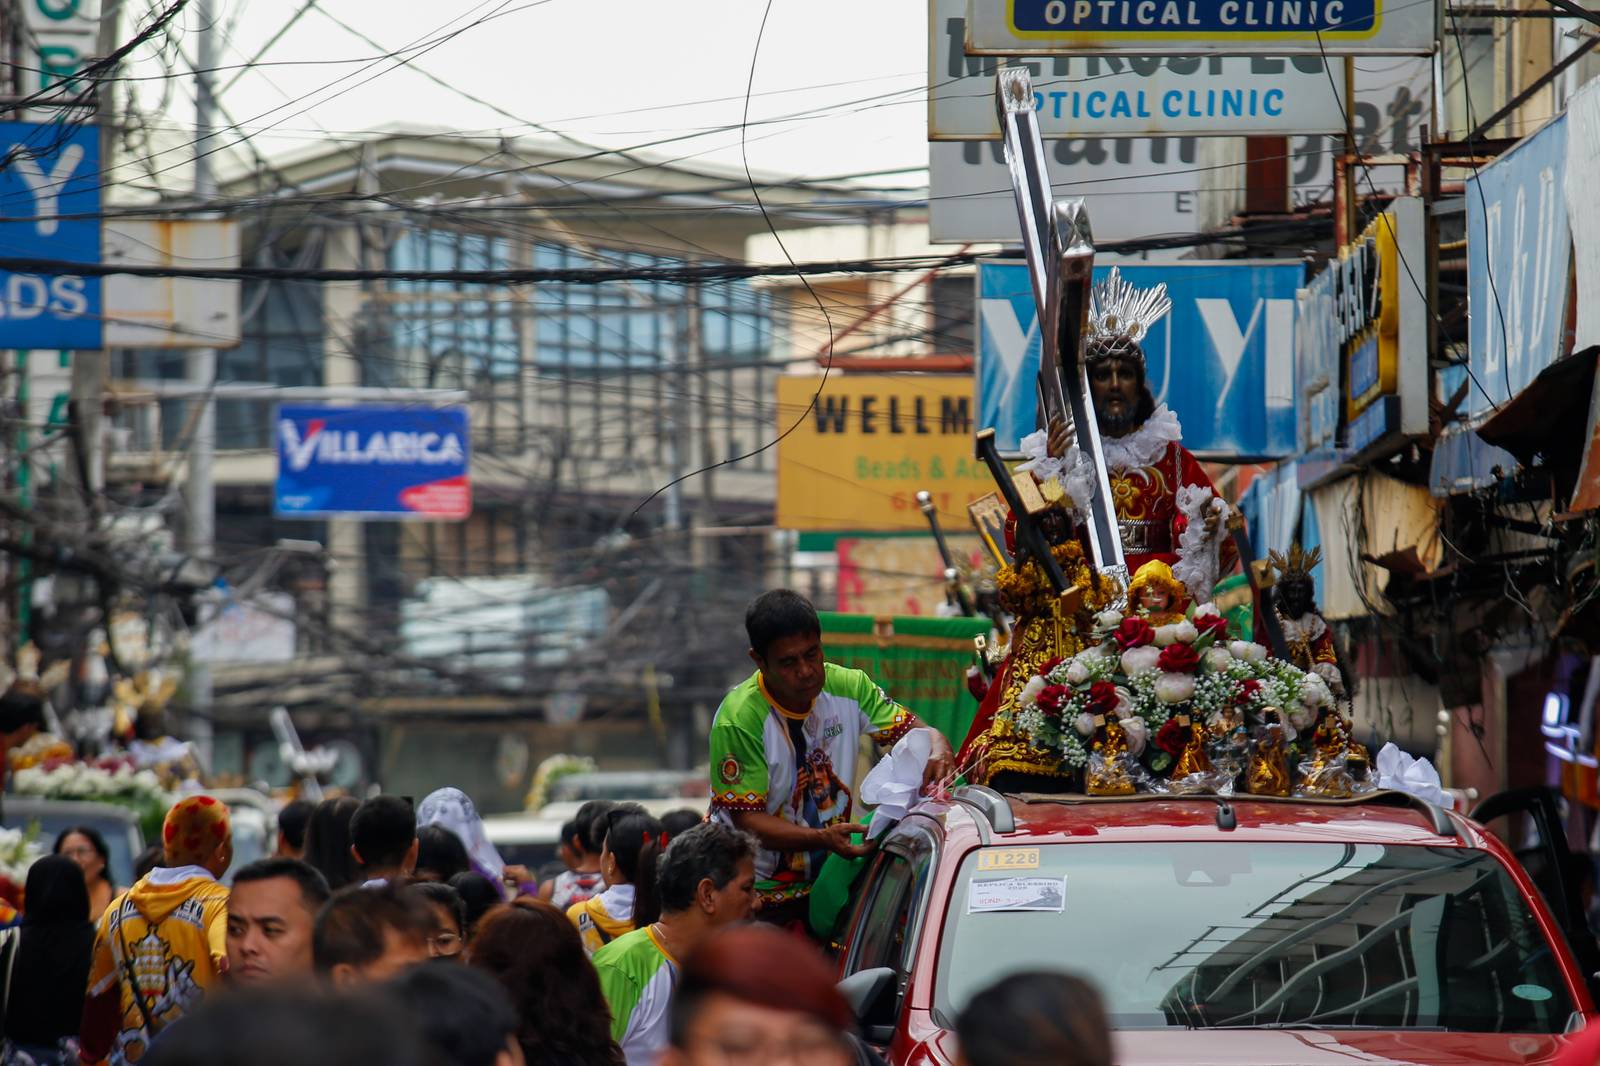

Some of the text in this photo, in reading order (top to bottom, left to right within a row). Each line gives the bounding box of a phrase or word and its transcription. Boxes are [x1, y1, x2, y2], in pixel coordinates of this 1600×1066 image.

[1045, 0, 1344, 25] OPTICAL CLINIC
[1031, 88, 1284, 119] PTICAL CLINIC
[0, 274, 87, 320] DS
[278, 417, 466, 471] VILLARICA
[856, 456, 920, 480] Beads
[929, 457, 944, 480] &
